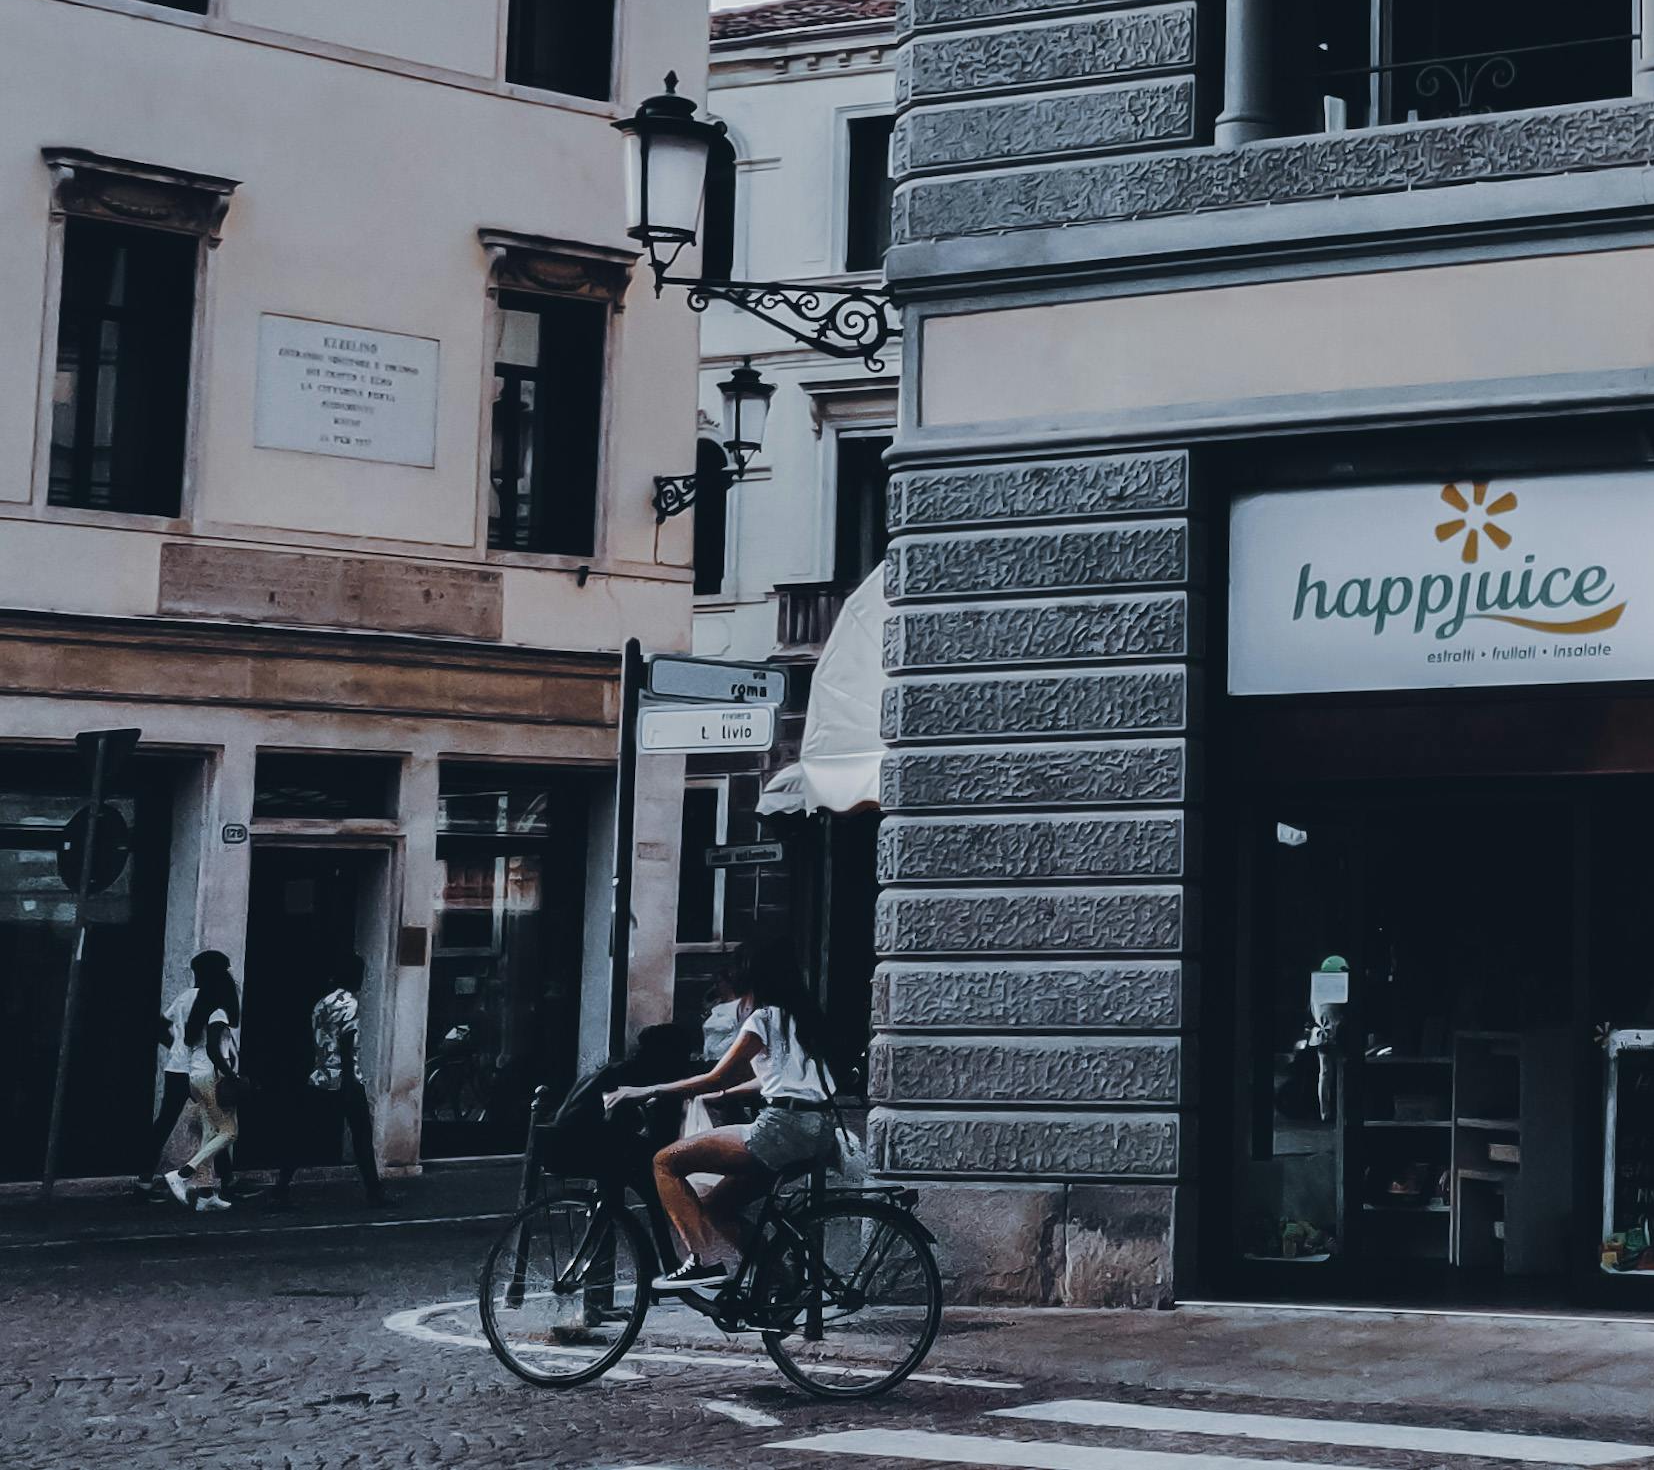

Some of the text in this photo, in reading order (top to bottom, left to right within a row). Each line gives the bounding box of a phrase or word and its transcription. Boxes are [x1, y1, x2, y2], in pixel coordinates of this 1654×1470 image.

[1427, 642, 1612, 663] estratti frullati insalate
[753, 672, 766, 680] via
[731, 684, 767, 697] roma
[722, 712, 751, 720] riviera
[722, 725, 751, 739] livio
